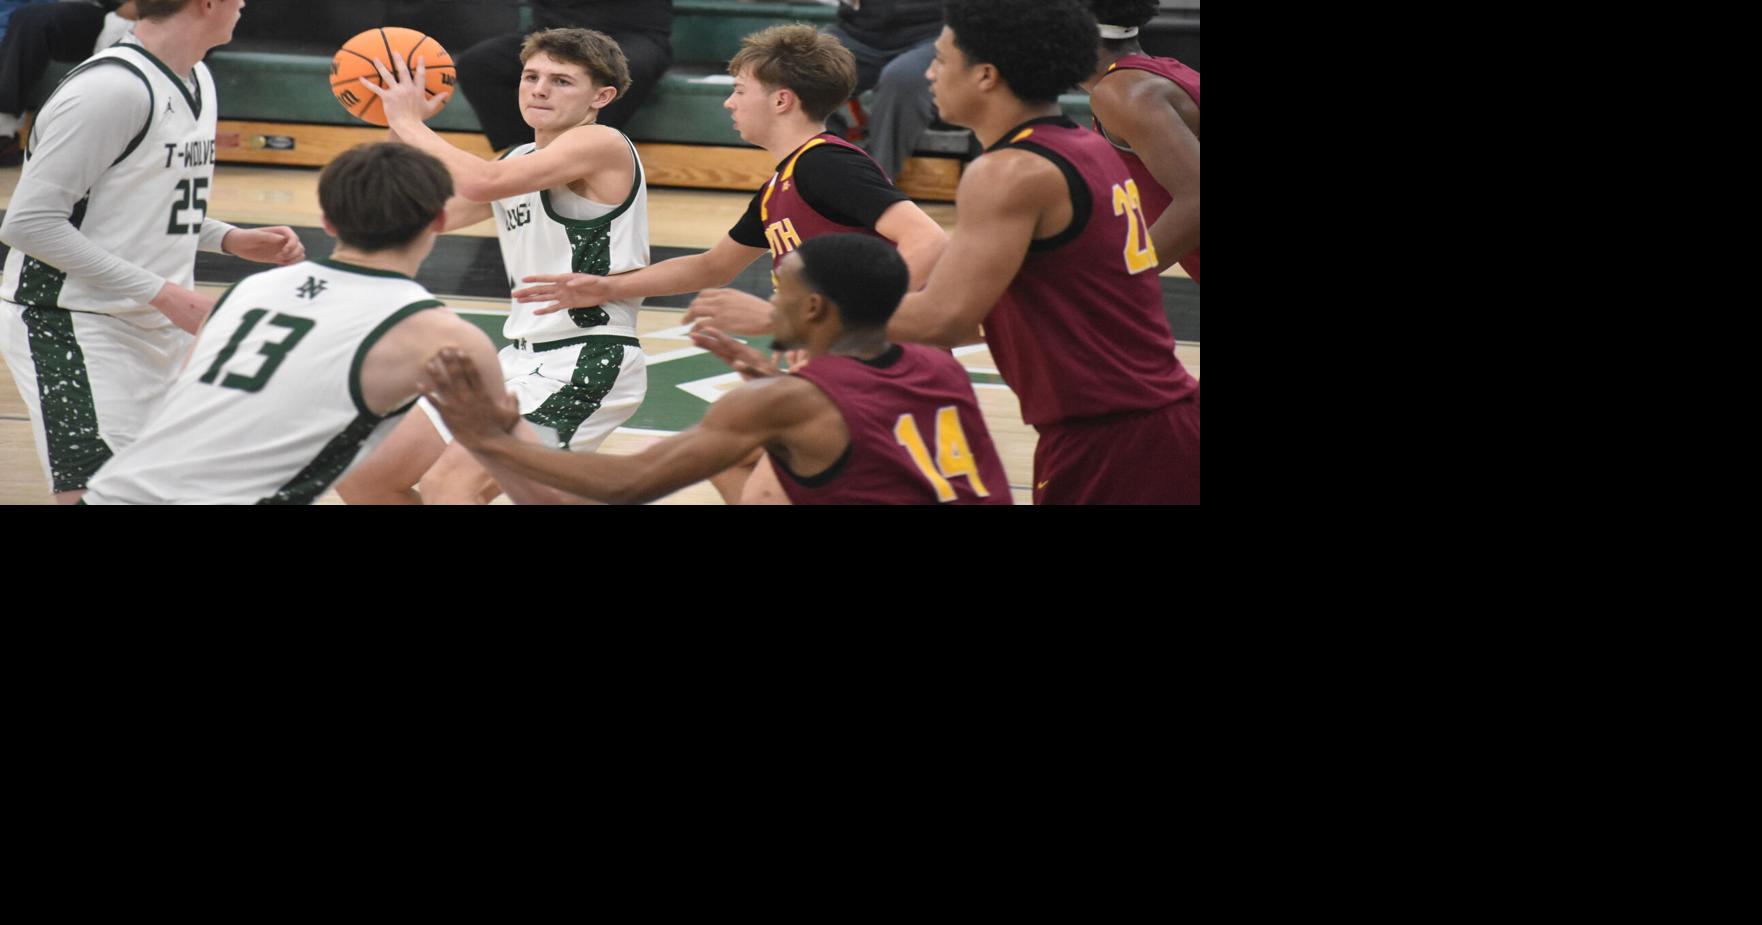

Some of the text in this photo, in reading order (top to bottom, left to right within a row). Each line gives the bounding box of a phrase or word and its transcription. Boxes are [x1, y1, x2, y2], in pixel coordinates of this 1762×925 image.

[164, 139, 216, 168] T-WOLVE
[166, 177, 209, 235] 25
[197, 307, 317, 394] 13
[893, 405, 991, 503] 14
